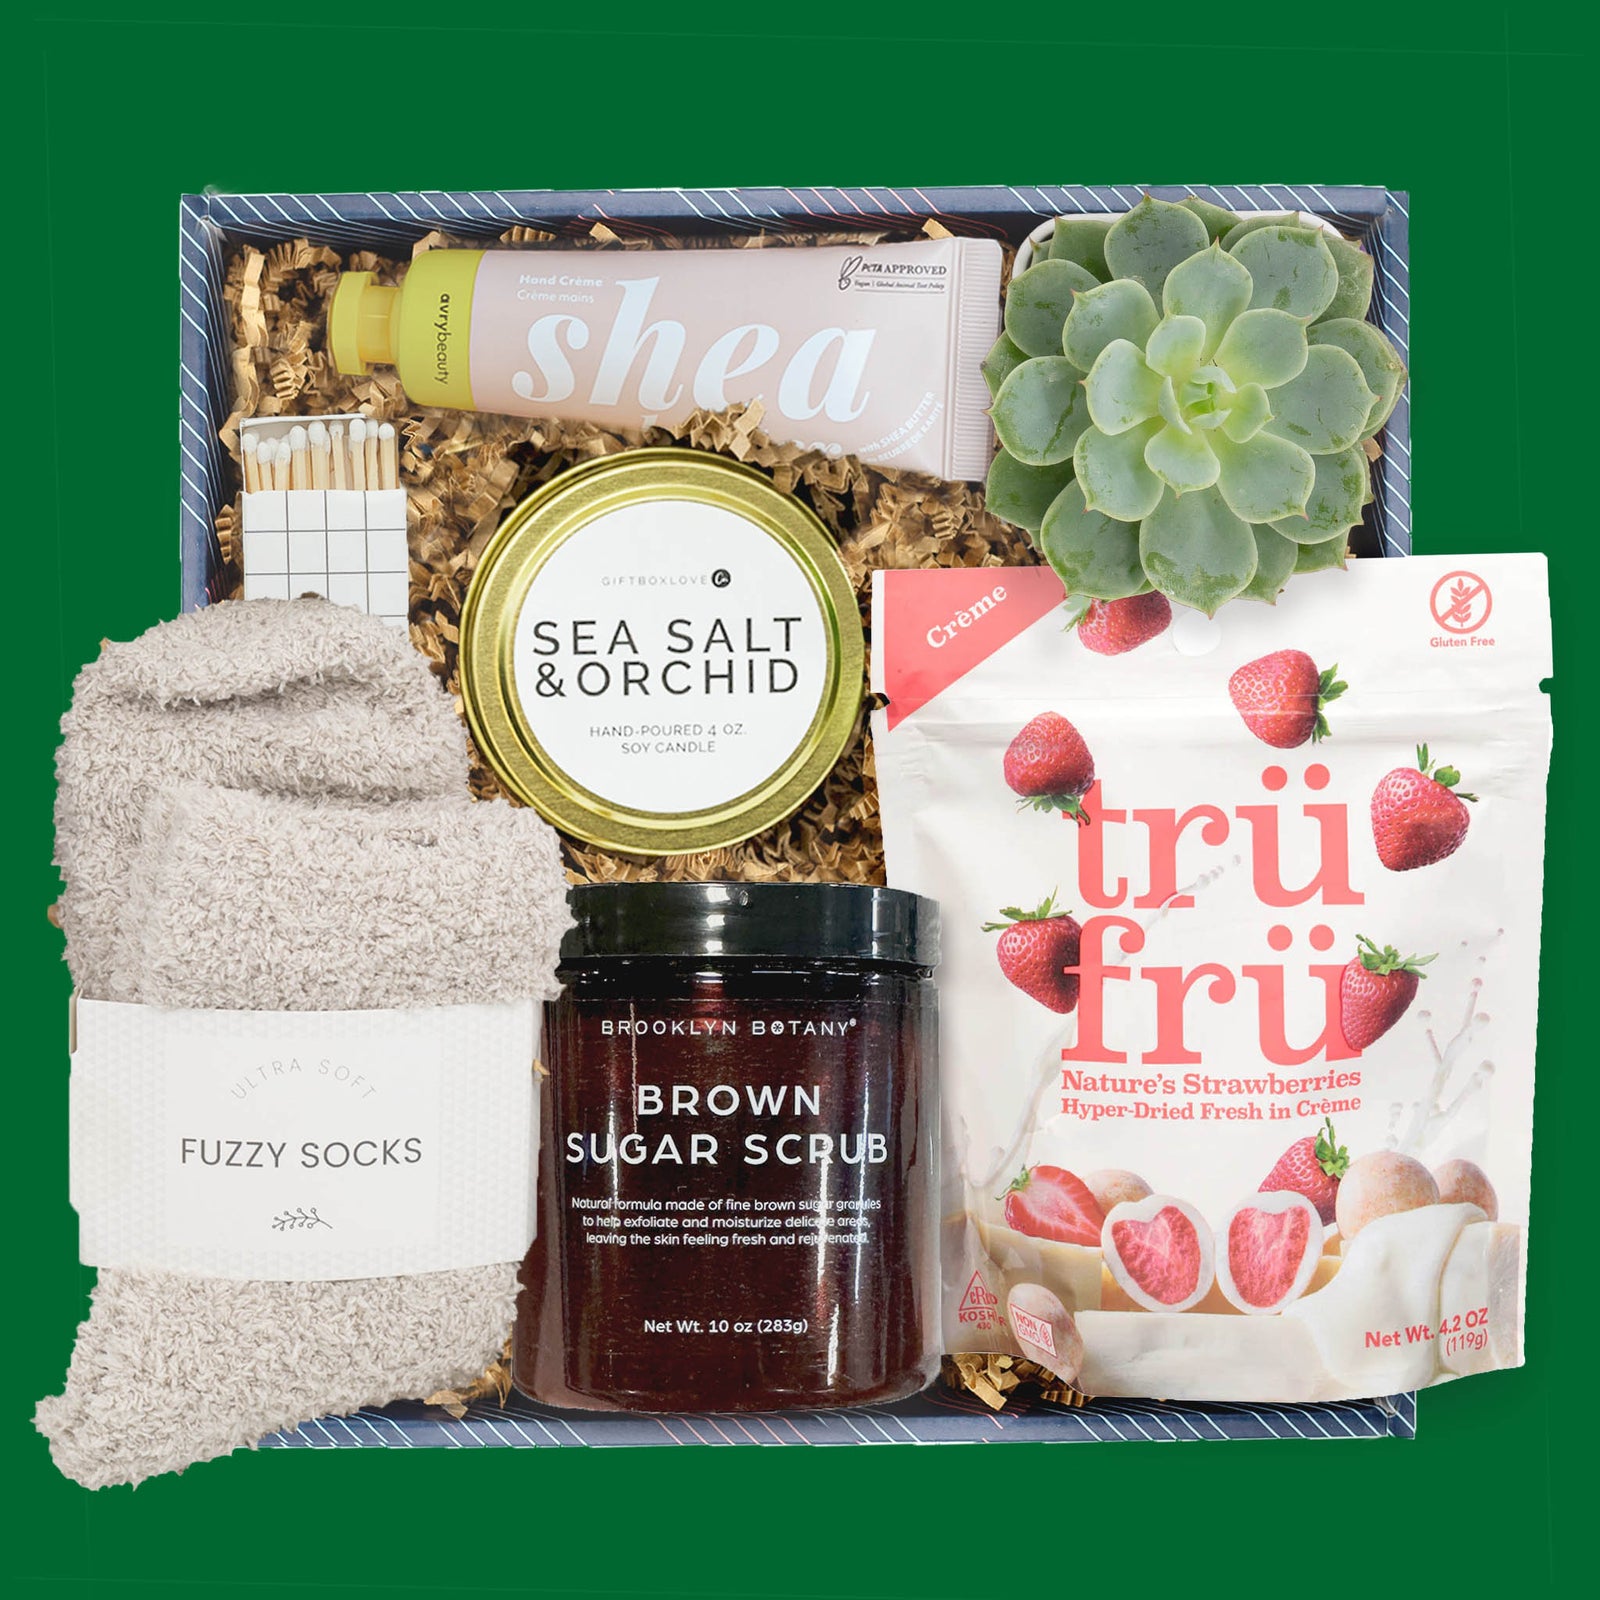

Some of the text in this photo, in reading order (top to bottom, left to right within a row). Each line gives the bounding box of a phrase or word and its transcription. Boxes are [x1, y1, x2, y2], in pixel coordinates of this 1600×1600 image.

[884, 264, 948, 276] APPROVED
[519, 275, 604, 288] Hand Crème
[516, 289, 595, 304] Crème mains
[434, 293, 451, 384] avrybeauty
[511, 276, 876, 423] shea
[859, 441, 881, 453] with
[879, 426, 909, 448] SHEA
[904, 391, 936, 430] BUTTER
[601, 576, 708, 586] GIFTBOXLOVE
[926, 585, 1008, 648] Crème
[533, 617, 802, 656] SEA SALT
[1430, 636, 1496, 648] Gluten Free
[534, 658, 799, 698] &ORCHID
[589, 722, 748, 738] HAND-POURED 4 OZ.
[621, 740, 717, 755] SOY CANDLE
[1065, 763, 1364, 909] trü
[1061, 915, 1362, 1066] frü
[601, 1020, 736, 1035] BROOKLYN
[231, 1058, 376, 1099] ULTRA SOFT
[1061, 1069, 1361, 1095] Nature’s Strawberries
[638, 1085, 821, 1116] BROWN
[1061, 1097, 1361, 1121] Hyper-Dried Fresh in Crème
[181, 1137, 422, 1169] FUZZY SOCKS
[566, 1132, 888, 1165] SUGAR SCRUB
[571, 1197, 613, 1210] Natural
[613, 1198, 662, 1211] formula
[665, 1198, 705, 1211] made
[708, 1199, 723, 1211] of
[726, 1198, 751, 1211] fine
[754, 1198, 795, 1211] brown
[583, 1215, 595, 1227] to
[597, 1215, 622, 1229] help
[623, 1215, 678, 1228] exfoliate
[682, 1216, 708, 1228] and
[711, 1216, 781, 1228] moisturize
[586, 1232, 628, 1247] leaving
[630, 1233, 651, 1245] the
[654, 1233, 680, 1246] skin
[683, 1233, 729, 1247] feeling
[732, 1233, 766, 1246] fresh
[769, 1233, 795, 1246] and
[644, 1318, 809, 1335] Net Wt. 10 oz (283g)
[959, 1310, 1007, 1327] KOSHR
[976, 1322, 991, 1331] 430
[1015, 1311, 1038, 1332] NON
[1365, 1307, 1489, 1348] Net Wt. 4.2 OZ
[1018, 1324, 1041, 1344] GMO
[1445, 1328, 1489, 1356] (119g)
